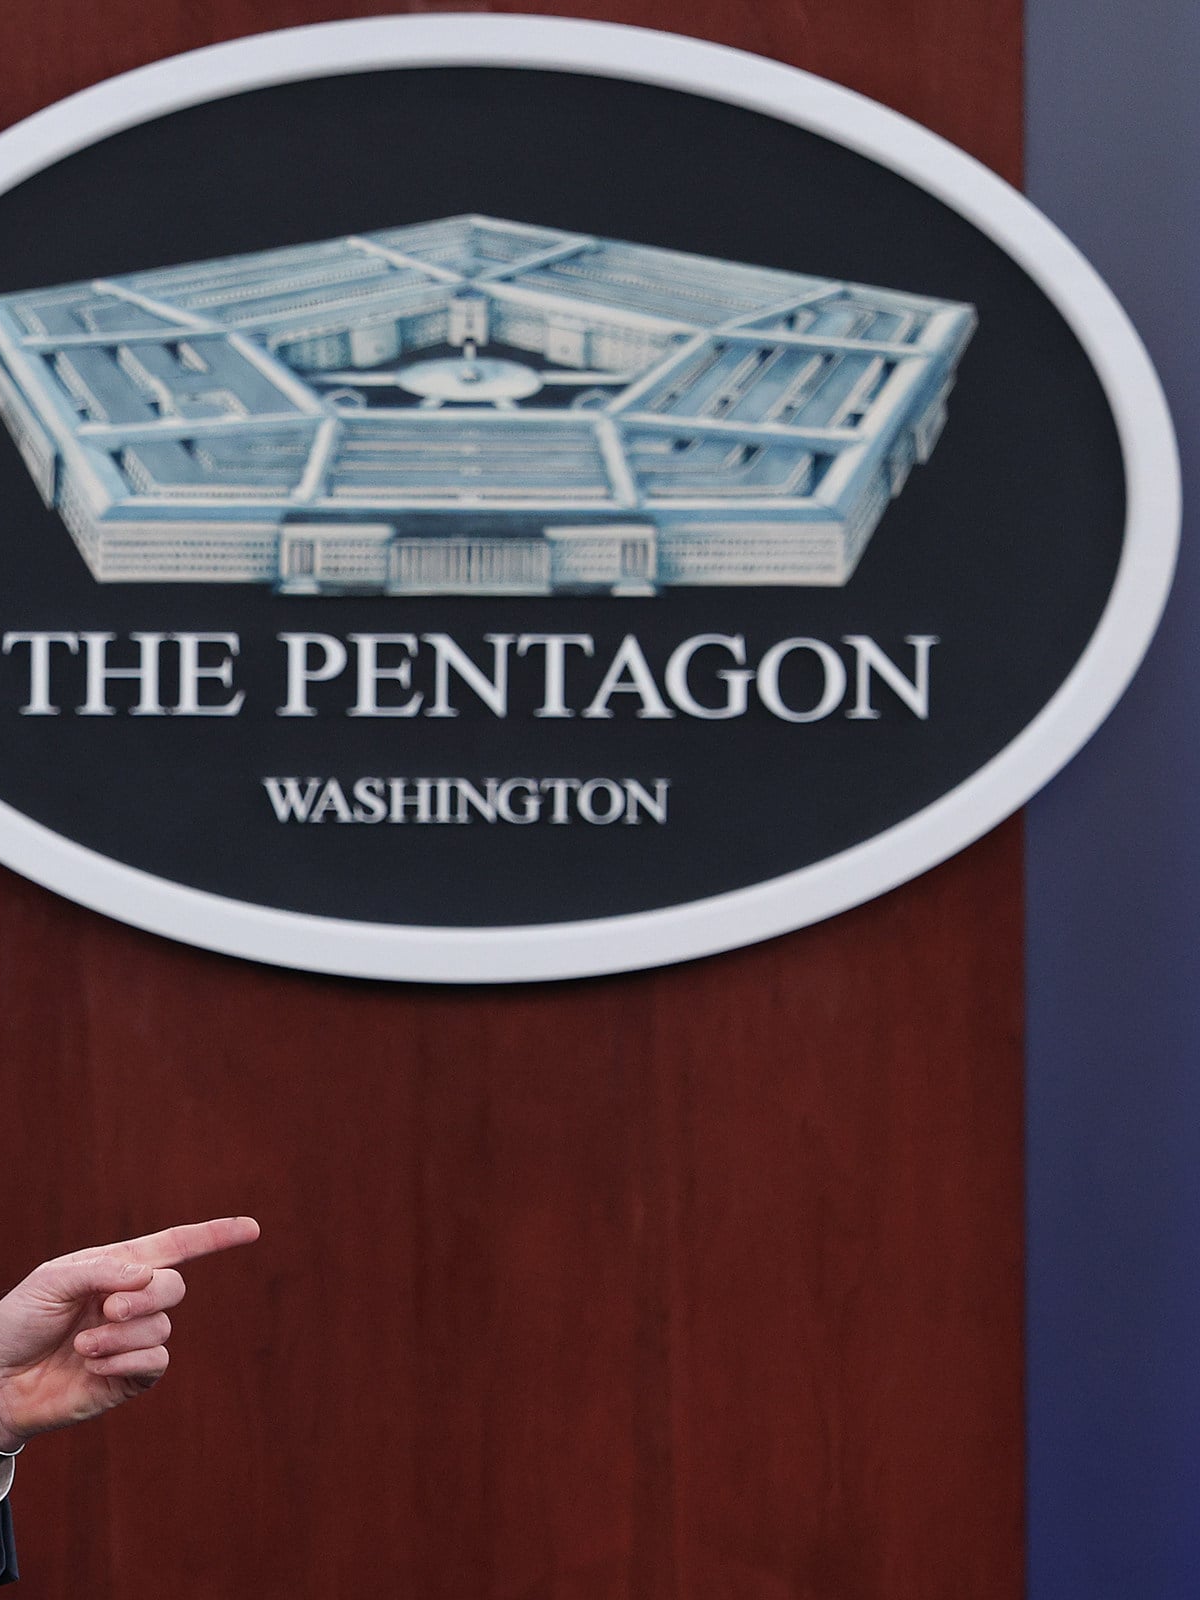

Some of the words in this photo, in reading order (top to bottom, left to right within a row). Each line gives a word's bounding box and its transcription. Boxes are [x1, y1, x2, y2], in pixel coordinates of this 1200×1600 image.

[2, 631, 246, 718] THE
[277, 631, 939, 723] PENTAGON
[263, 776, 670, 826] WASHINGTON
